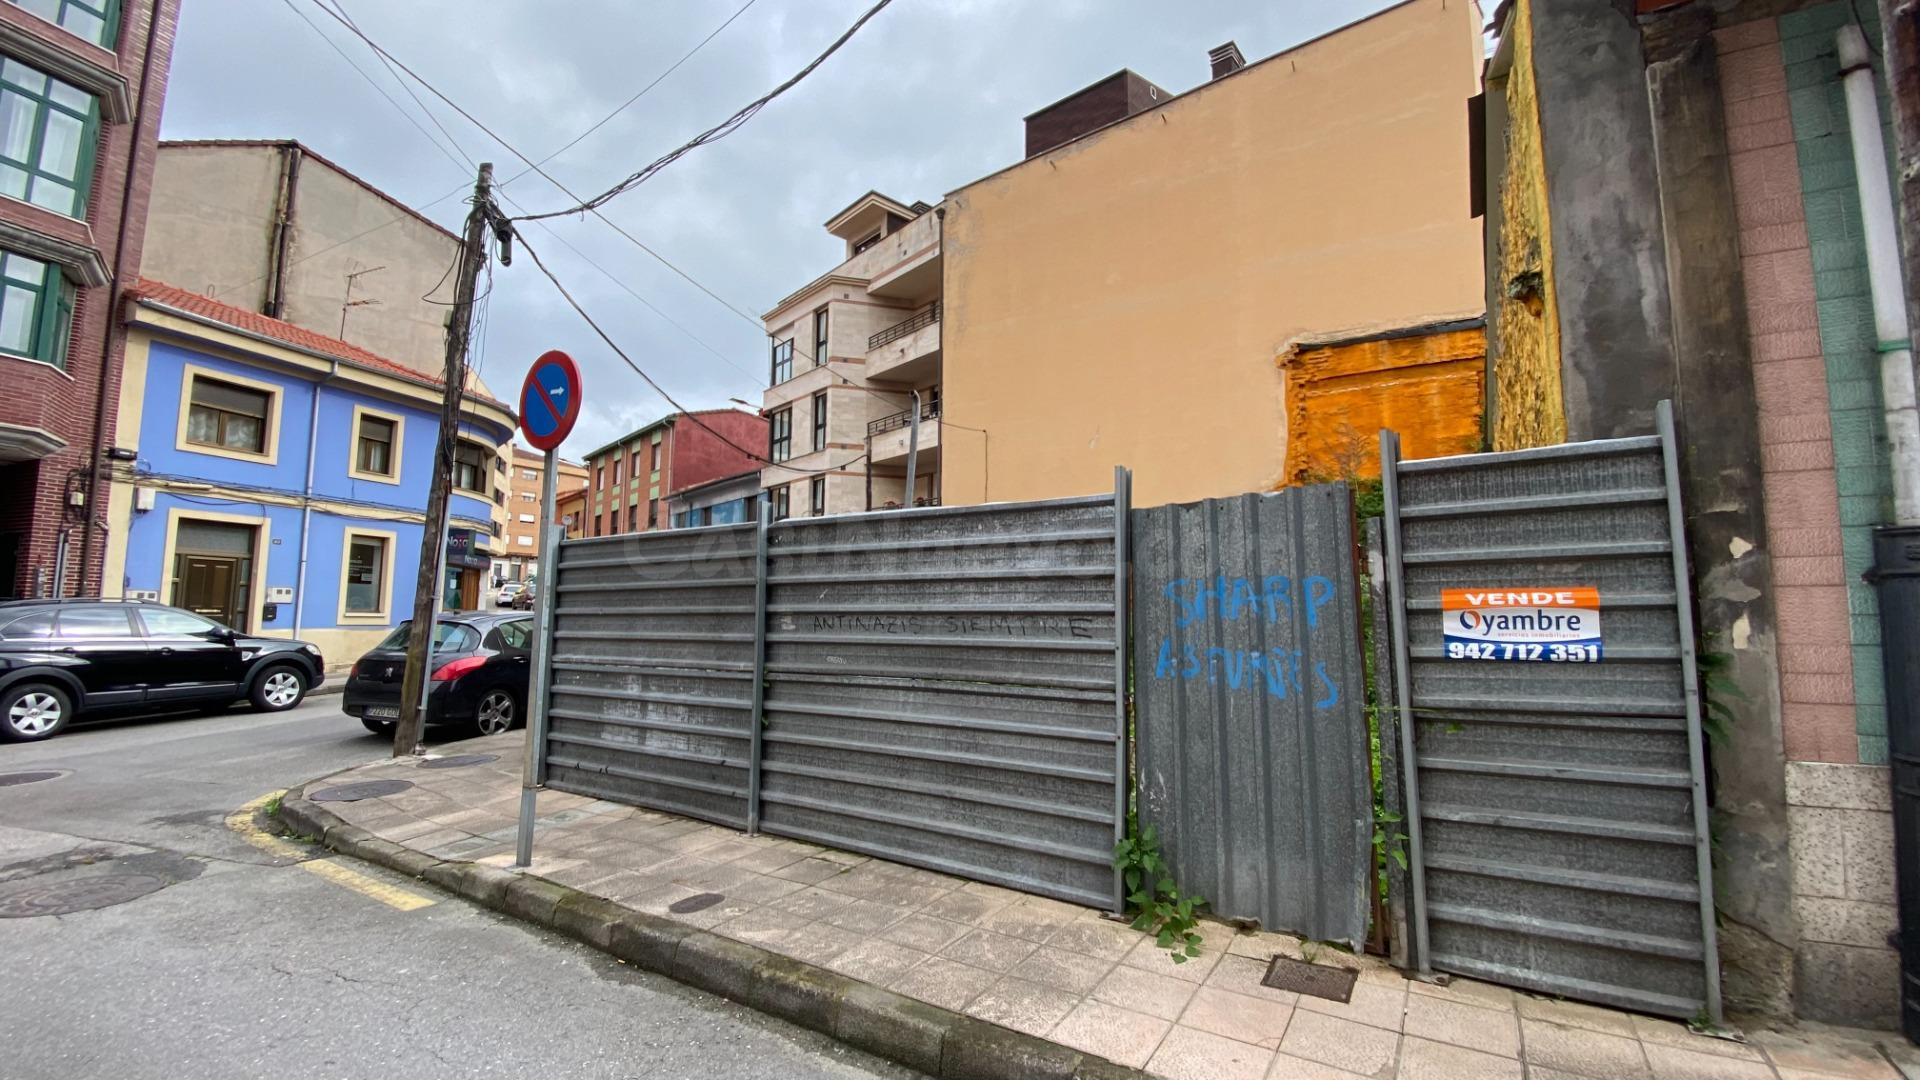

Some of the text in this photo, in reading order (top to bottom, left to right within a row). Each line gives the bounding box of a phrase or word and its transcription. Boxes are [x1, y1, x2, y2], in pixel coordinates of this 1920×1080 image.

[1162, 575, 1335, 631] SHARP
[1466, 592, 1575, 605] VENDE
[813, 615, 922, 635] ANTINAZIS
[1459, 609, 1581, 635] Oyambre
[1449, 642, 1598, 663] 942 712 351
